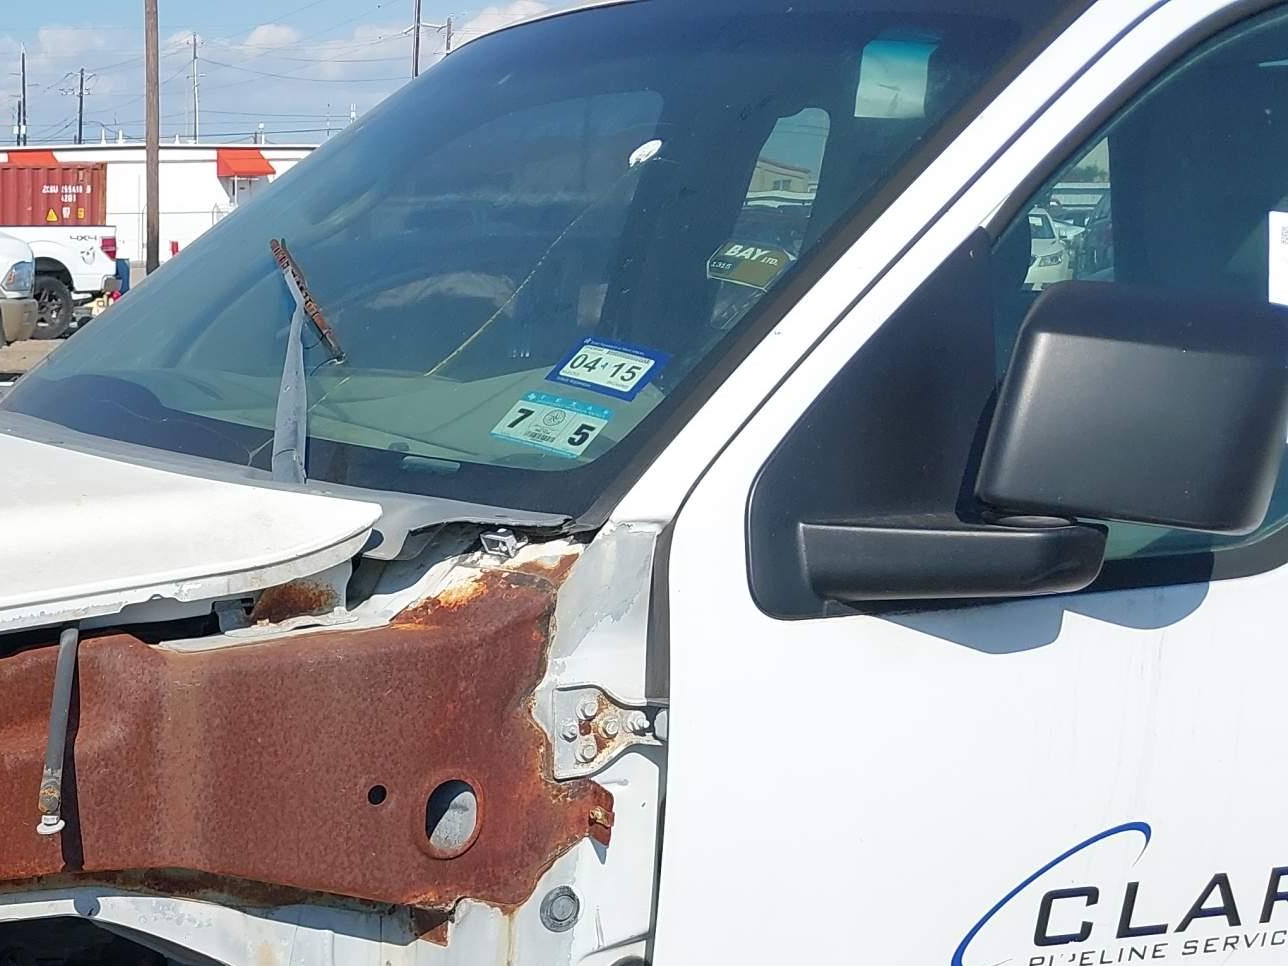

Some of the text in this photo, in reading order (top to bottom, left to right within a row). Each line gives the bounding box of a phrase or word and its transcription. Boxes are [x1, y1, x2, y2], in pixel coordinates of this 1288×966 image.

[724, 244, 772, 261] BAY
[569, 353, 603, 373] 04
[609, 361, 643, 382] 15
[507, 408, 535, 429] 7
[567, 423, 596, 446] 5
